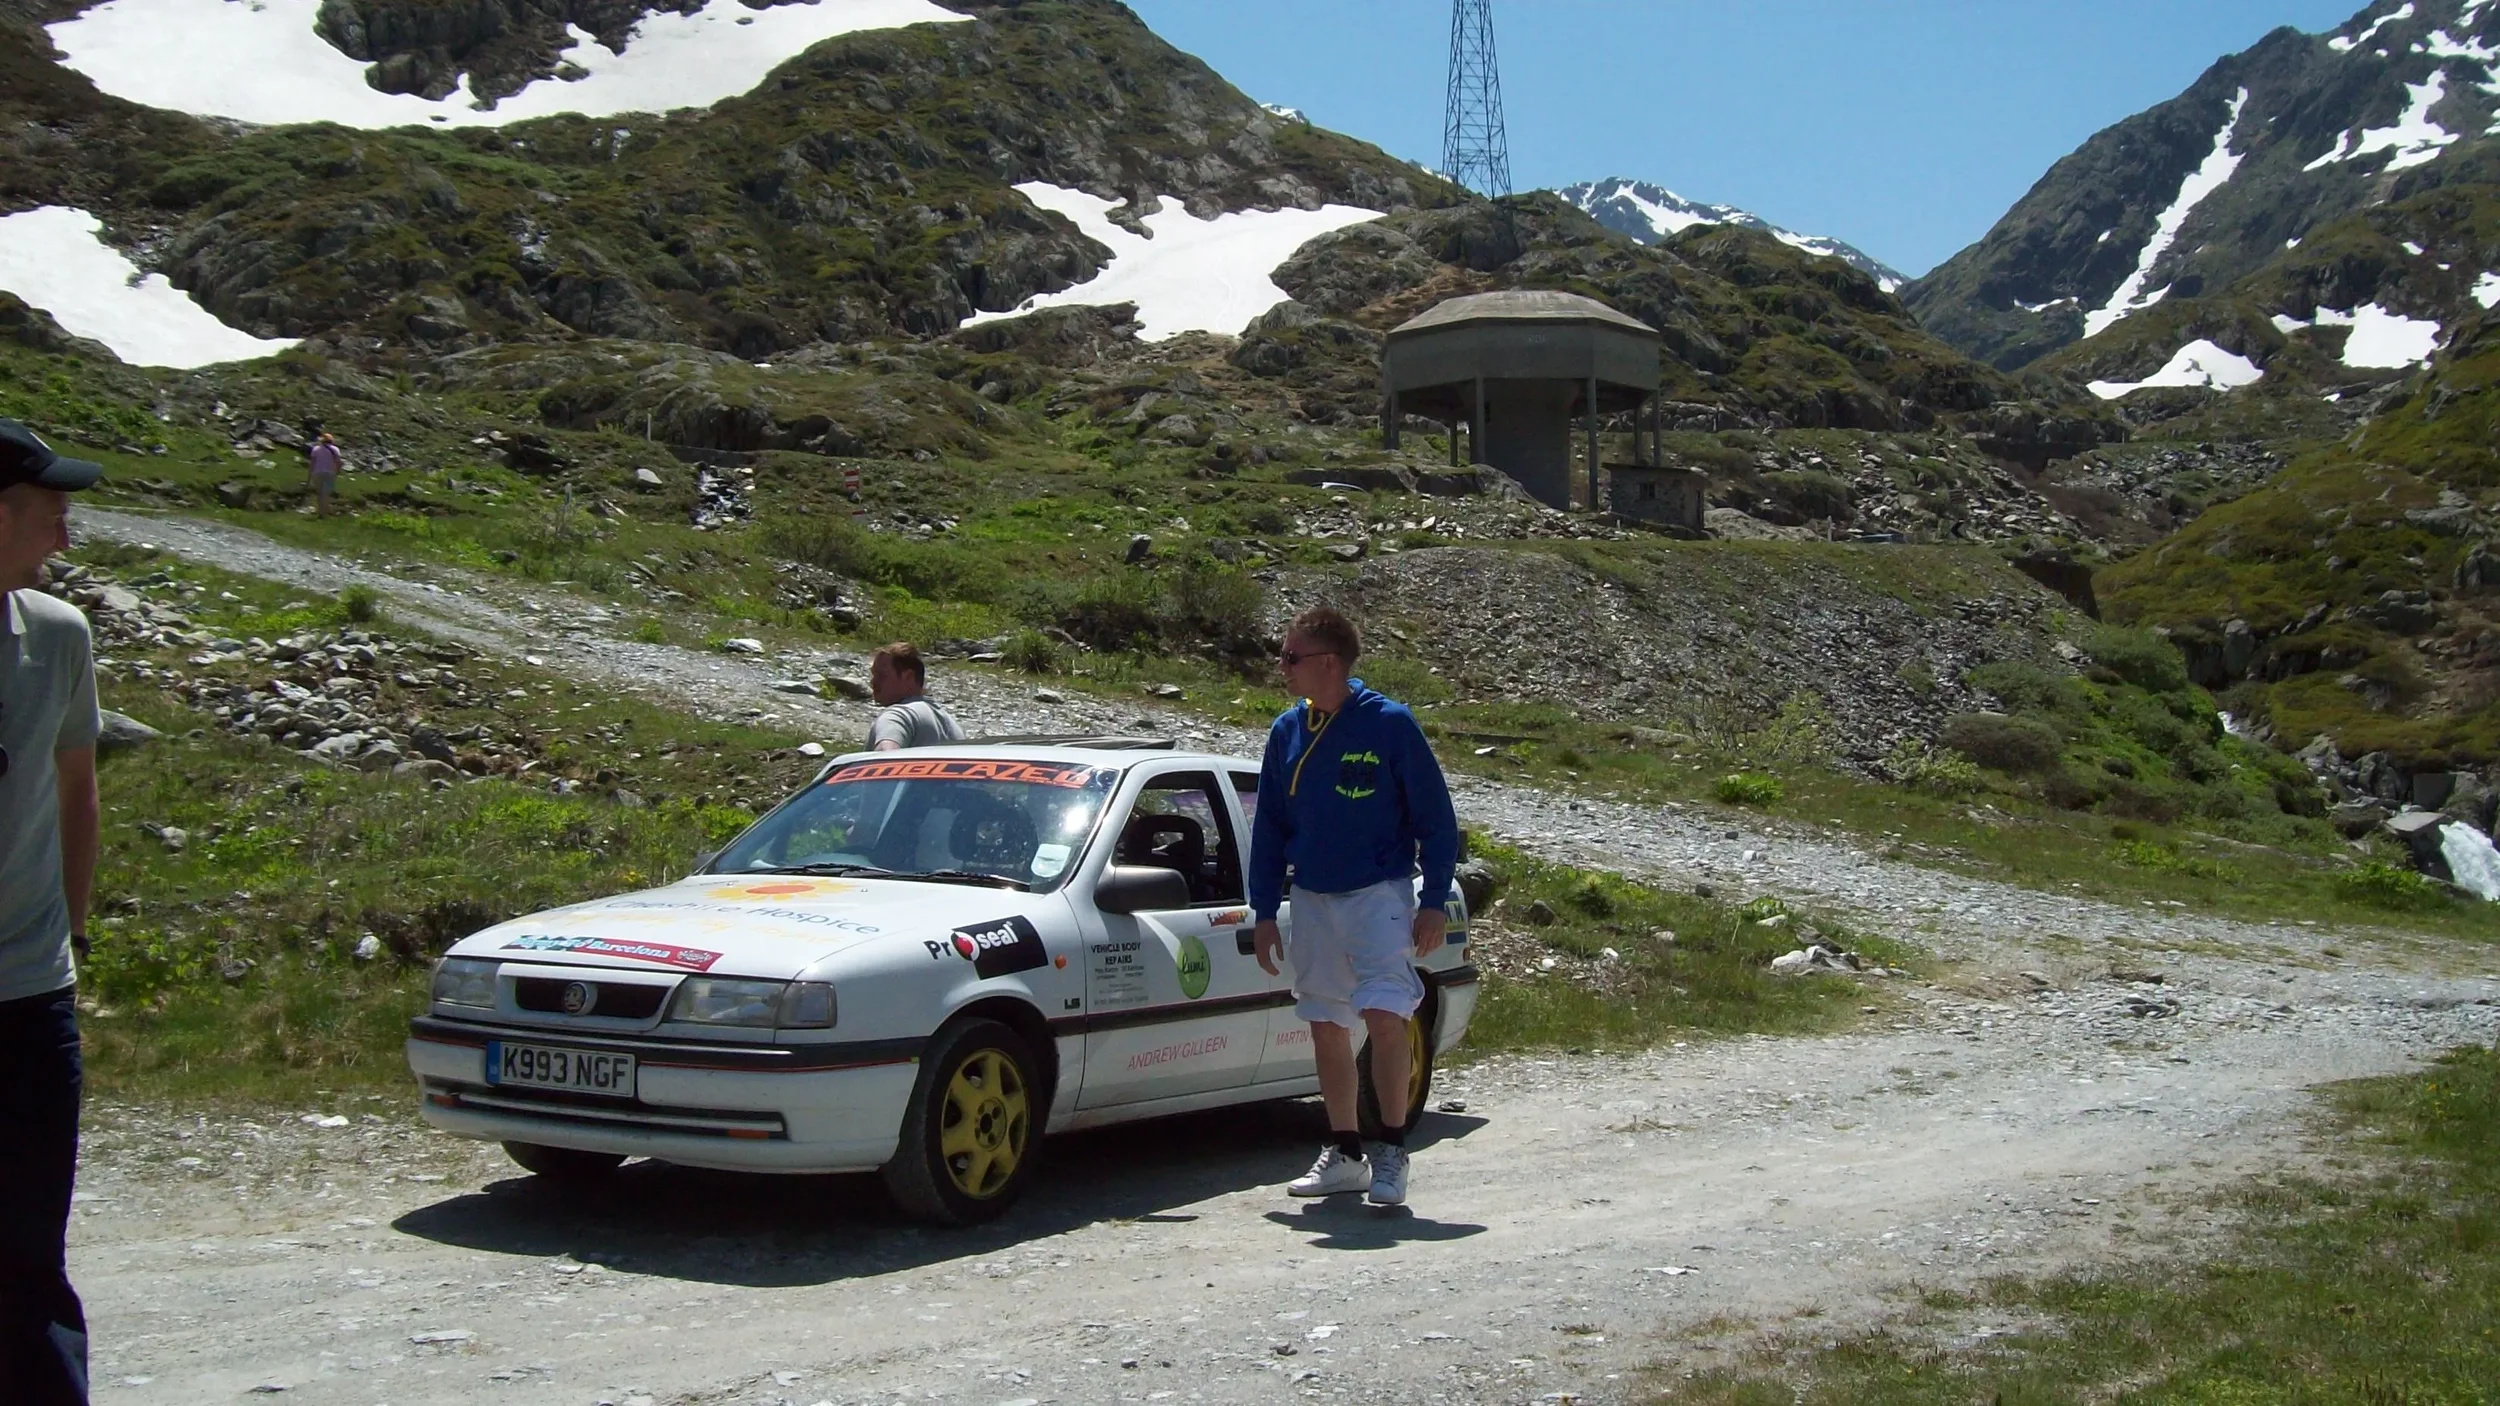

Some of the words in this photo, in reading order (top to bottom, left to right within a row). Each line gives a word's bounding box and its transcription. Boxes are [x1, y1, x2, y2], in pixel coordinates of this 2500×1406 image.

[747, 907, 880, 935] Hospice
[587, 940, 671, 959] Barcelona
[1091, 943, 1120, 953] VEHICLE
[1121, 942, 1141, 952] BODY
[1105, 954, 1132, 965] REPAIRS
[1127, 1045, 1181, 1070] ANDREW
[1182, 1035, 1228, 1058] GILLEEN
[504, 1047, 568, 1083] K993
[576, 1054, 629, 1088] NGF
